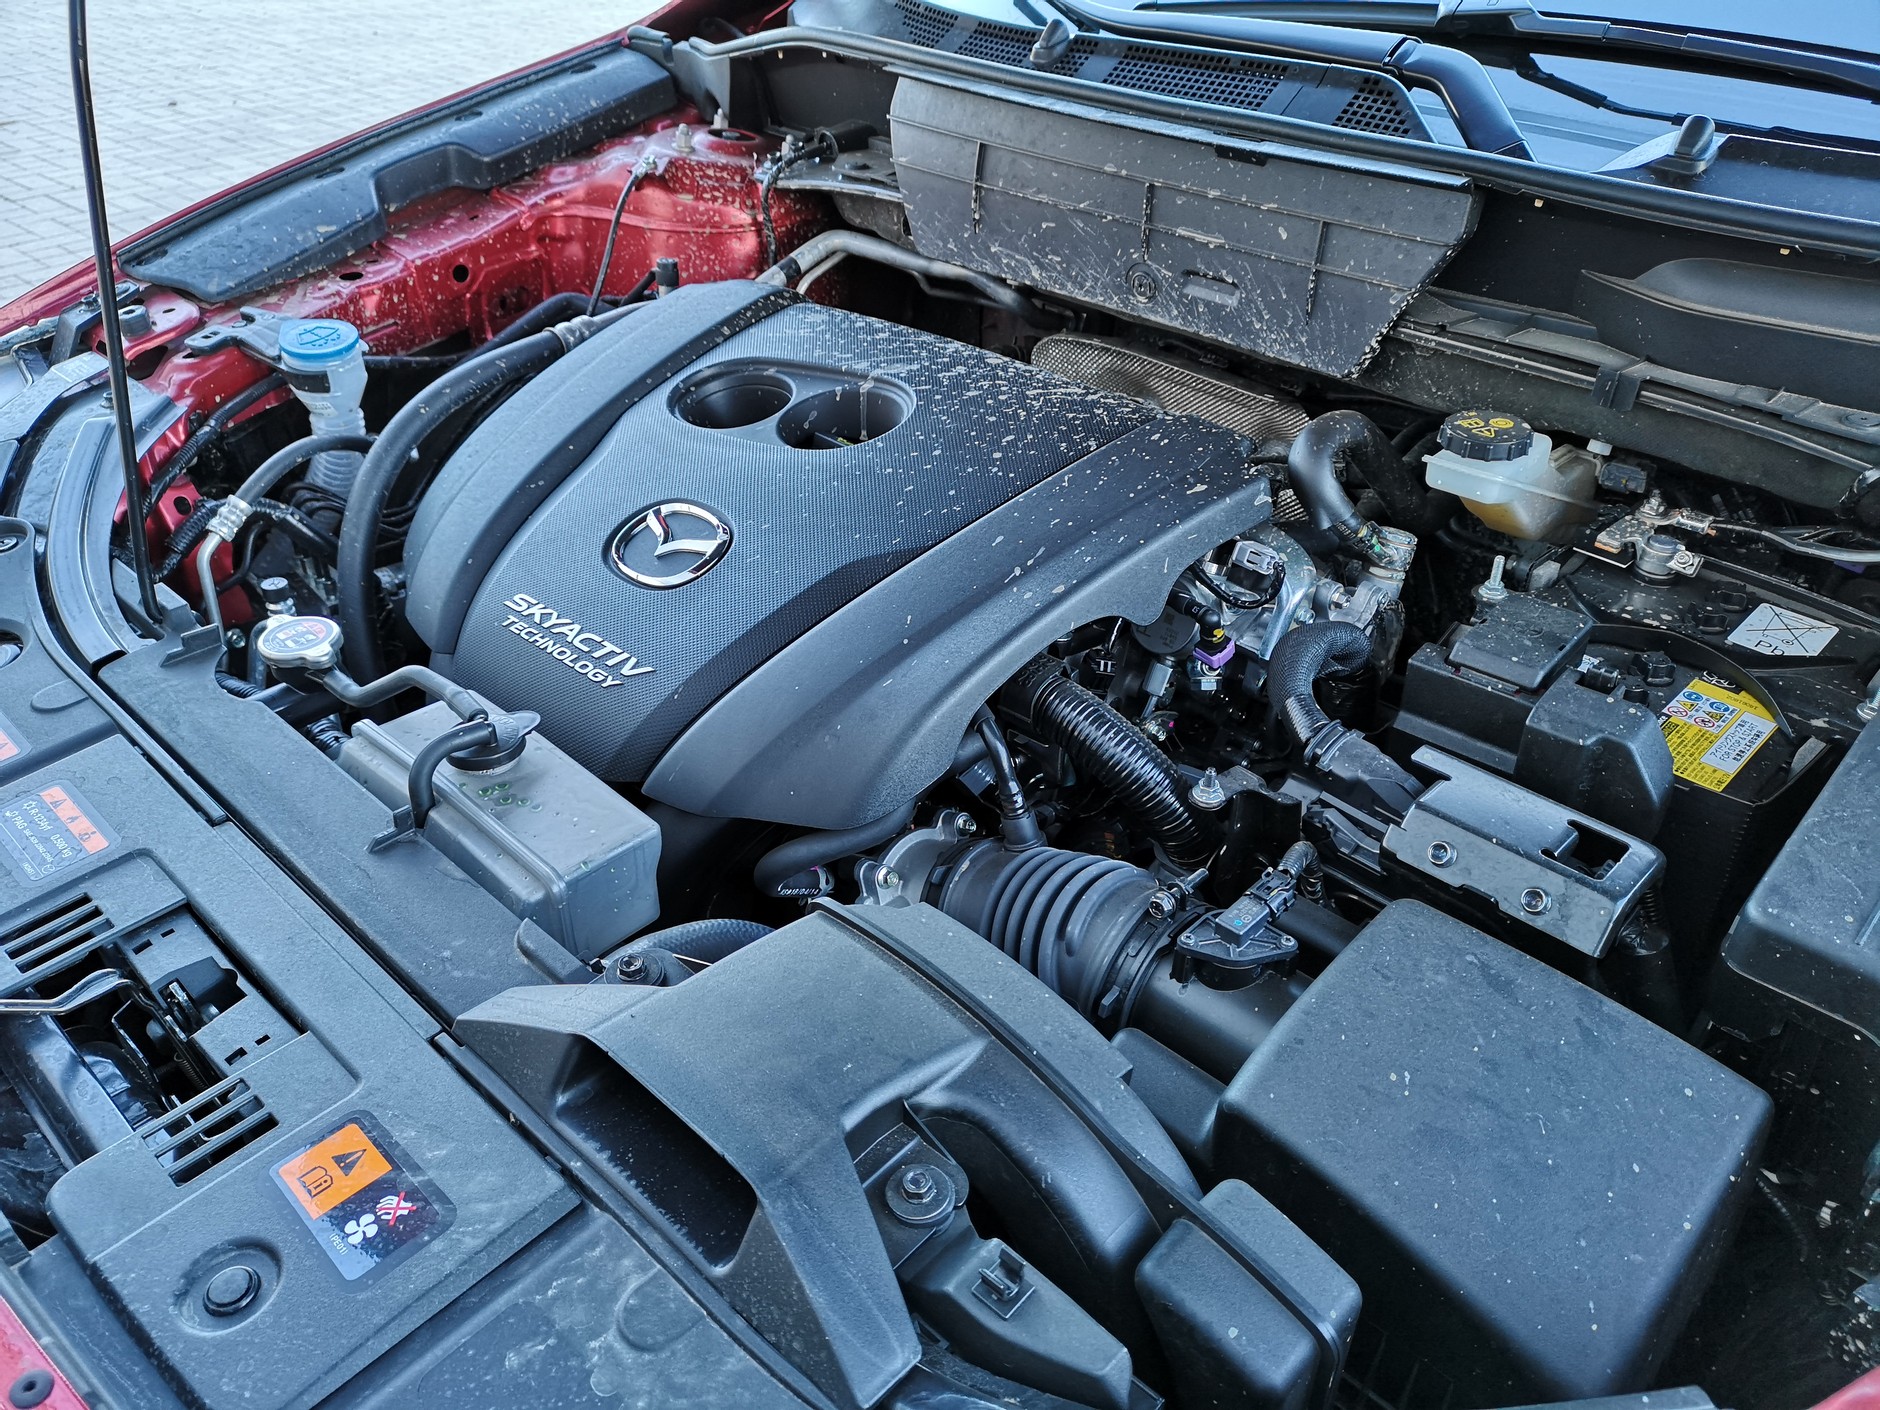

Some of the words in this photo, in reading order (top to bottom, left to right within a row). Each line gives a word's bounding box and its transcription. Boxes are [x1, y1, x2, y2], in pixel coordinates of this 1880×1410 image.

[503, 593, 656, 677] SKYACTIV
[501, 615, 624, 688] TECHNOLOGY
[1754, 640, 1786, 656] Pb
[1727, 738, 1743, 752] STOP
[1741, 722, 1759, 737] START
[11, 815, 27, 830] PAG
[50, 834, 68, 850] 0.500
[61, 847, 73, 858] kg
[328, 1233, 349, 1256] (PE01)
